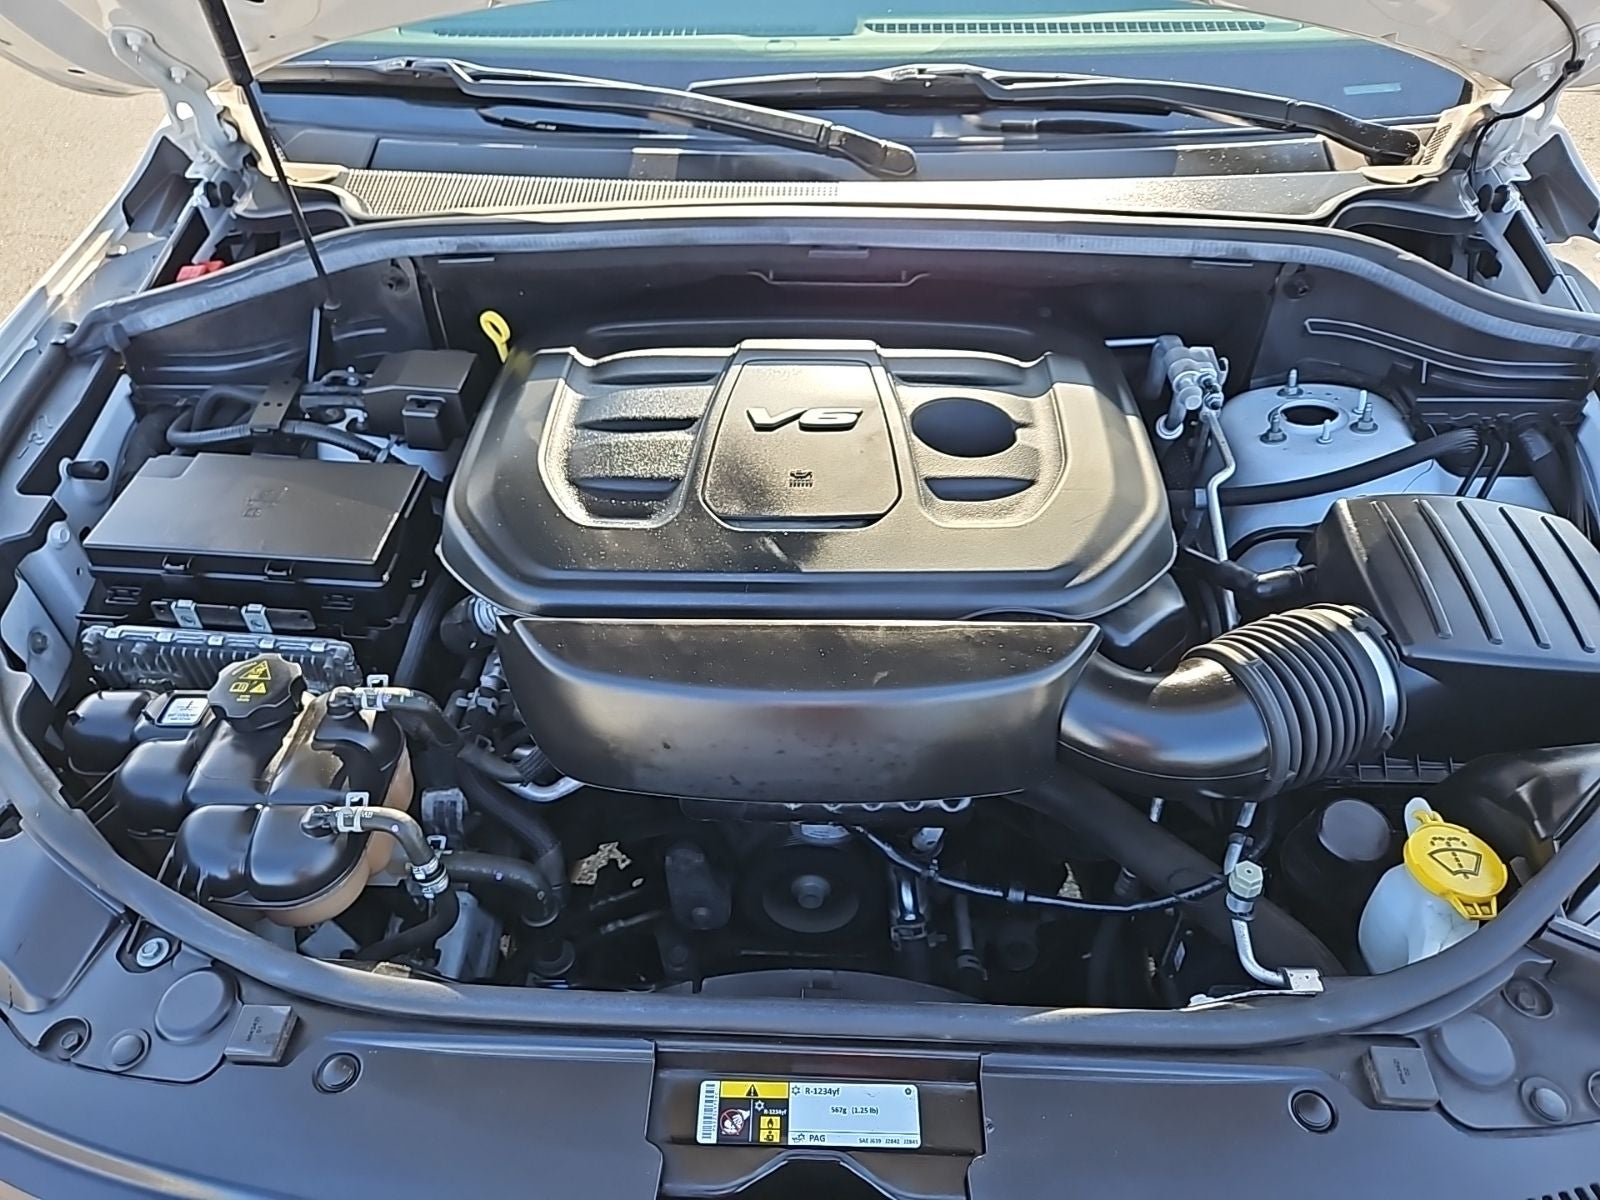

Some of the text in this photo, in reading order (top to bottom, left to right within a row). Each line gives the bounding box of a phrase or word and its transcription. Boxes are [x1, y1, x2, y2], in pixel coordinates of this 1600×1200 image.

[745, 406, 863, 432] V6
[805, 1087, 840, 1097] R-1234yf
[831, 1106, 879, 1115] 567g (1.25 lb)
[809, 1134, 826, 1142] PAG
